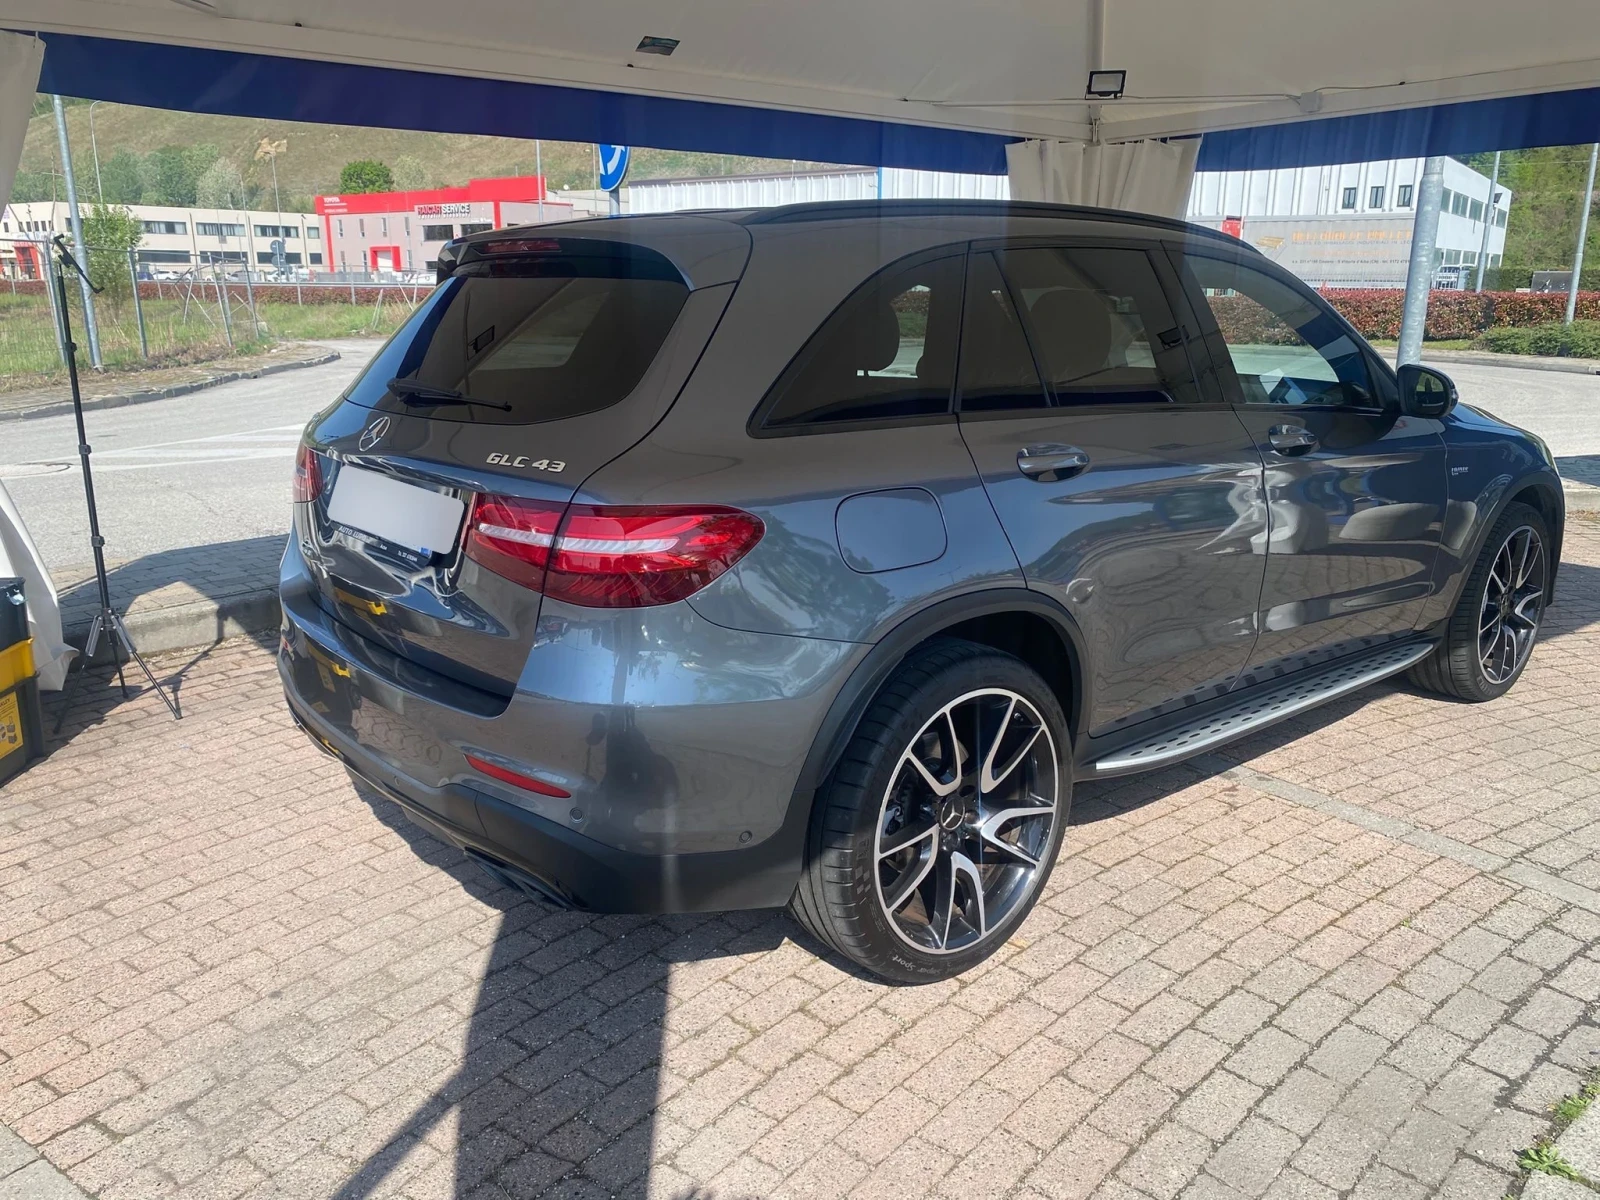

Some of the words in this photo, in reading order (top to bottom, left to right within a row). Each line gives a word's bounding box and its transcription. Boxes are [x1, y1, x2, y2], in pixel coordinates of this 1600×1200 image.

[442, 203, 471, 215] SERVICE
[486, 452, 530, 468] GLC
[531, 458, 566, 473] 43
[892, 954, 917, 972] Sport
